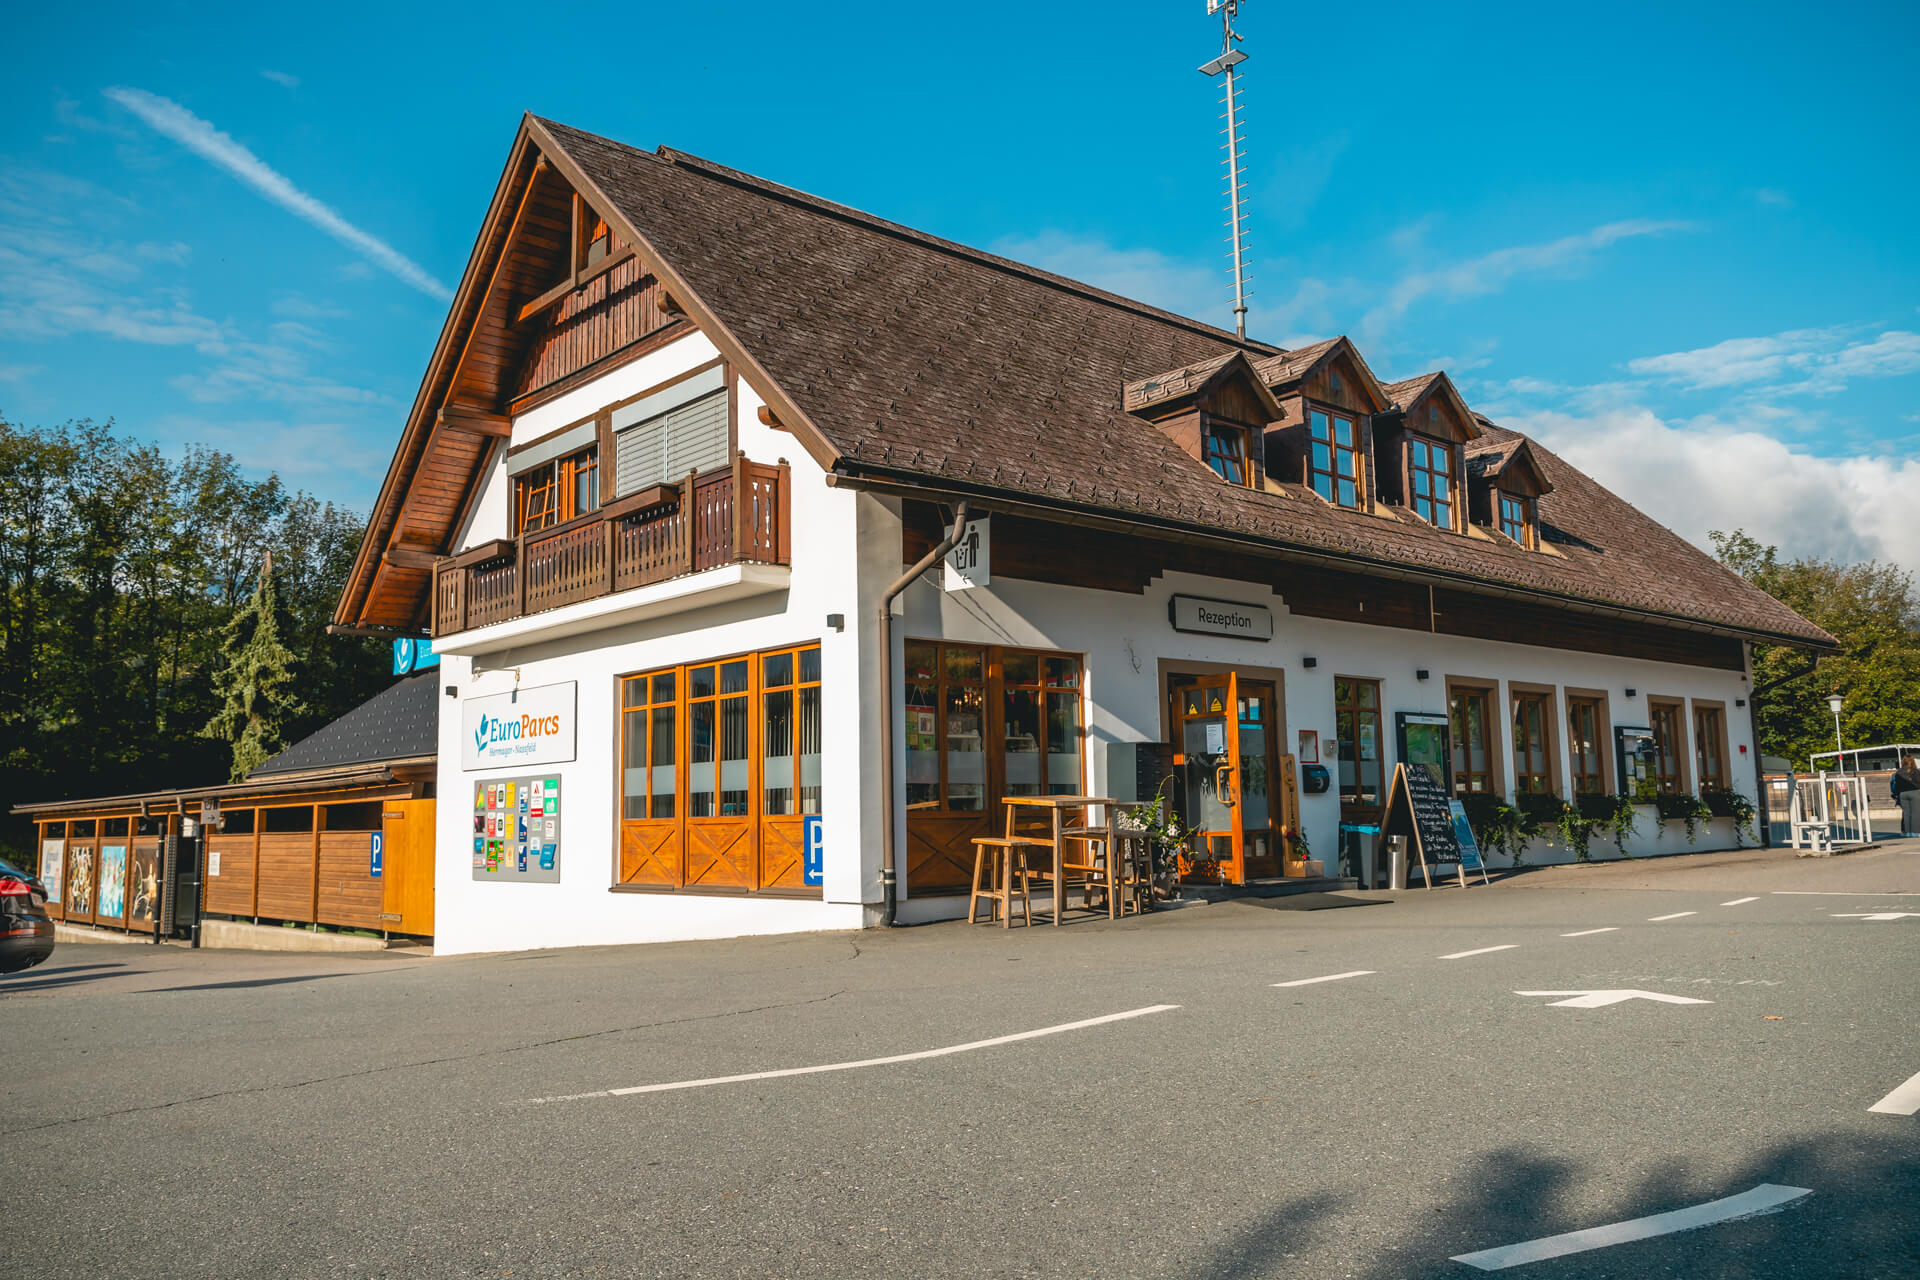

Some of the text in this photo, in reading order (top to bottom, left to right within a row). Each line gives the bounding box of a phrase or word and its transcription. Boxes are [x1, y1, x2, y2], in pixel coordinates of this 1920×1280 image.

[1198, 607, 1252, 629] Rezeption
[490, 713, 560, 743] EuroParcs
[373, 835, 381, 863] P
[810, 820, 823, 864] P
